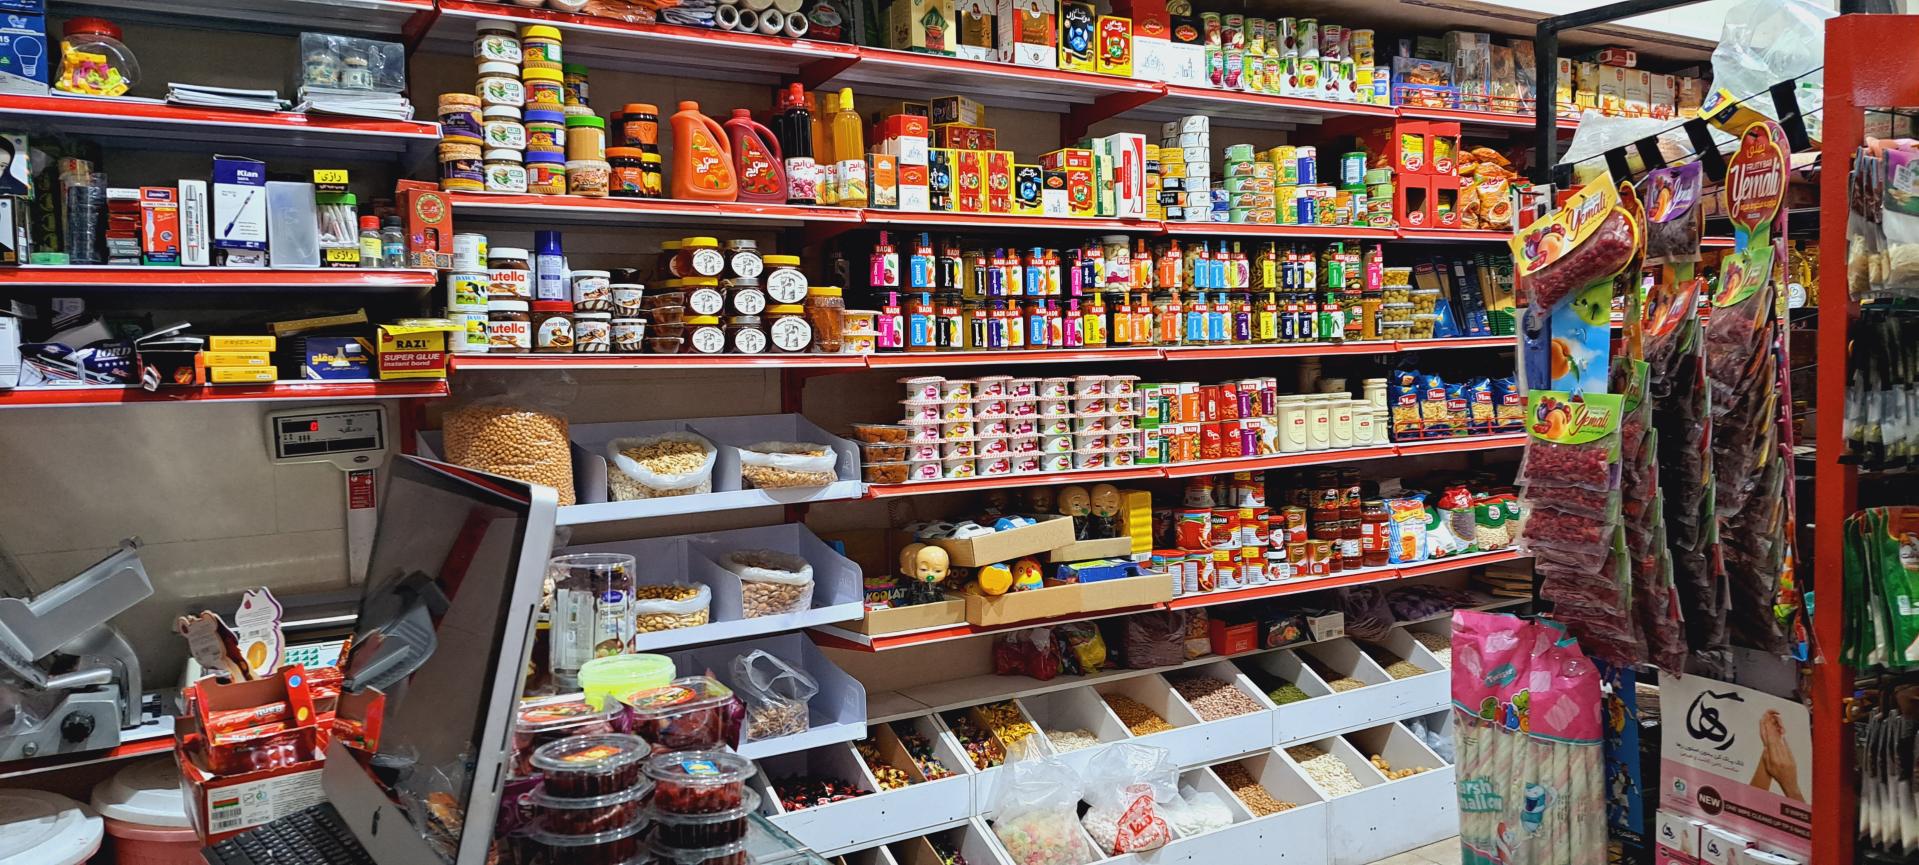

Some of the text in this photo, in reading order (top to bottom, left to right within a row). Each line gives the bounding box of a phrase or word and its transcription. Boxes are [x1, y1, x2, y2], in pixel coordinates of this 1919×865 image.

[236, 170, 258, 178] Kian
[321, 172, 342, 182] رازی
[1730, 157, 1780, 218] Yemali
[1566, 192, 1606, 242] Yemali
[334, 242, 354, 250] رازی
[486, 272, 524, 282] nutella
[487, 322, 524, 334] nutella
[396, 340, 426, 349] RAZI
[1569, 403, 1610, 436] Yemali
[866, 588, 908, 602] KOOLAT
[1699, 794, 1722, 808] NEW
